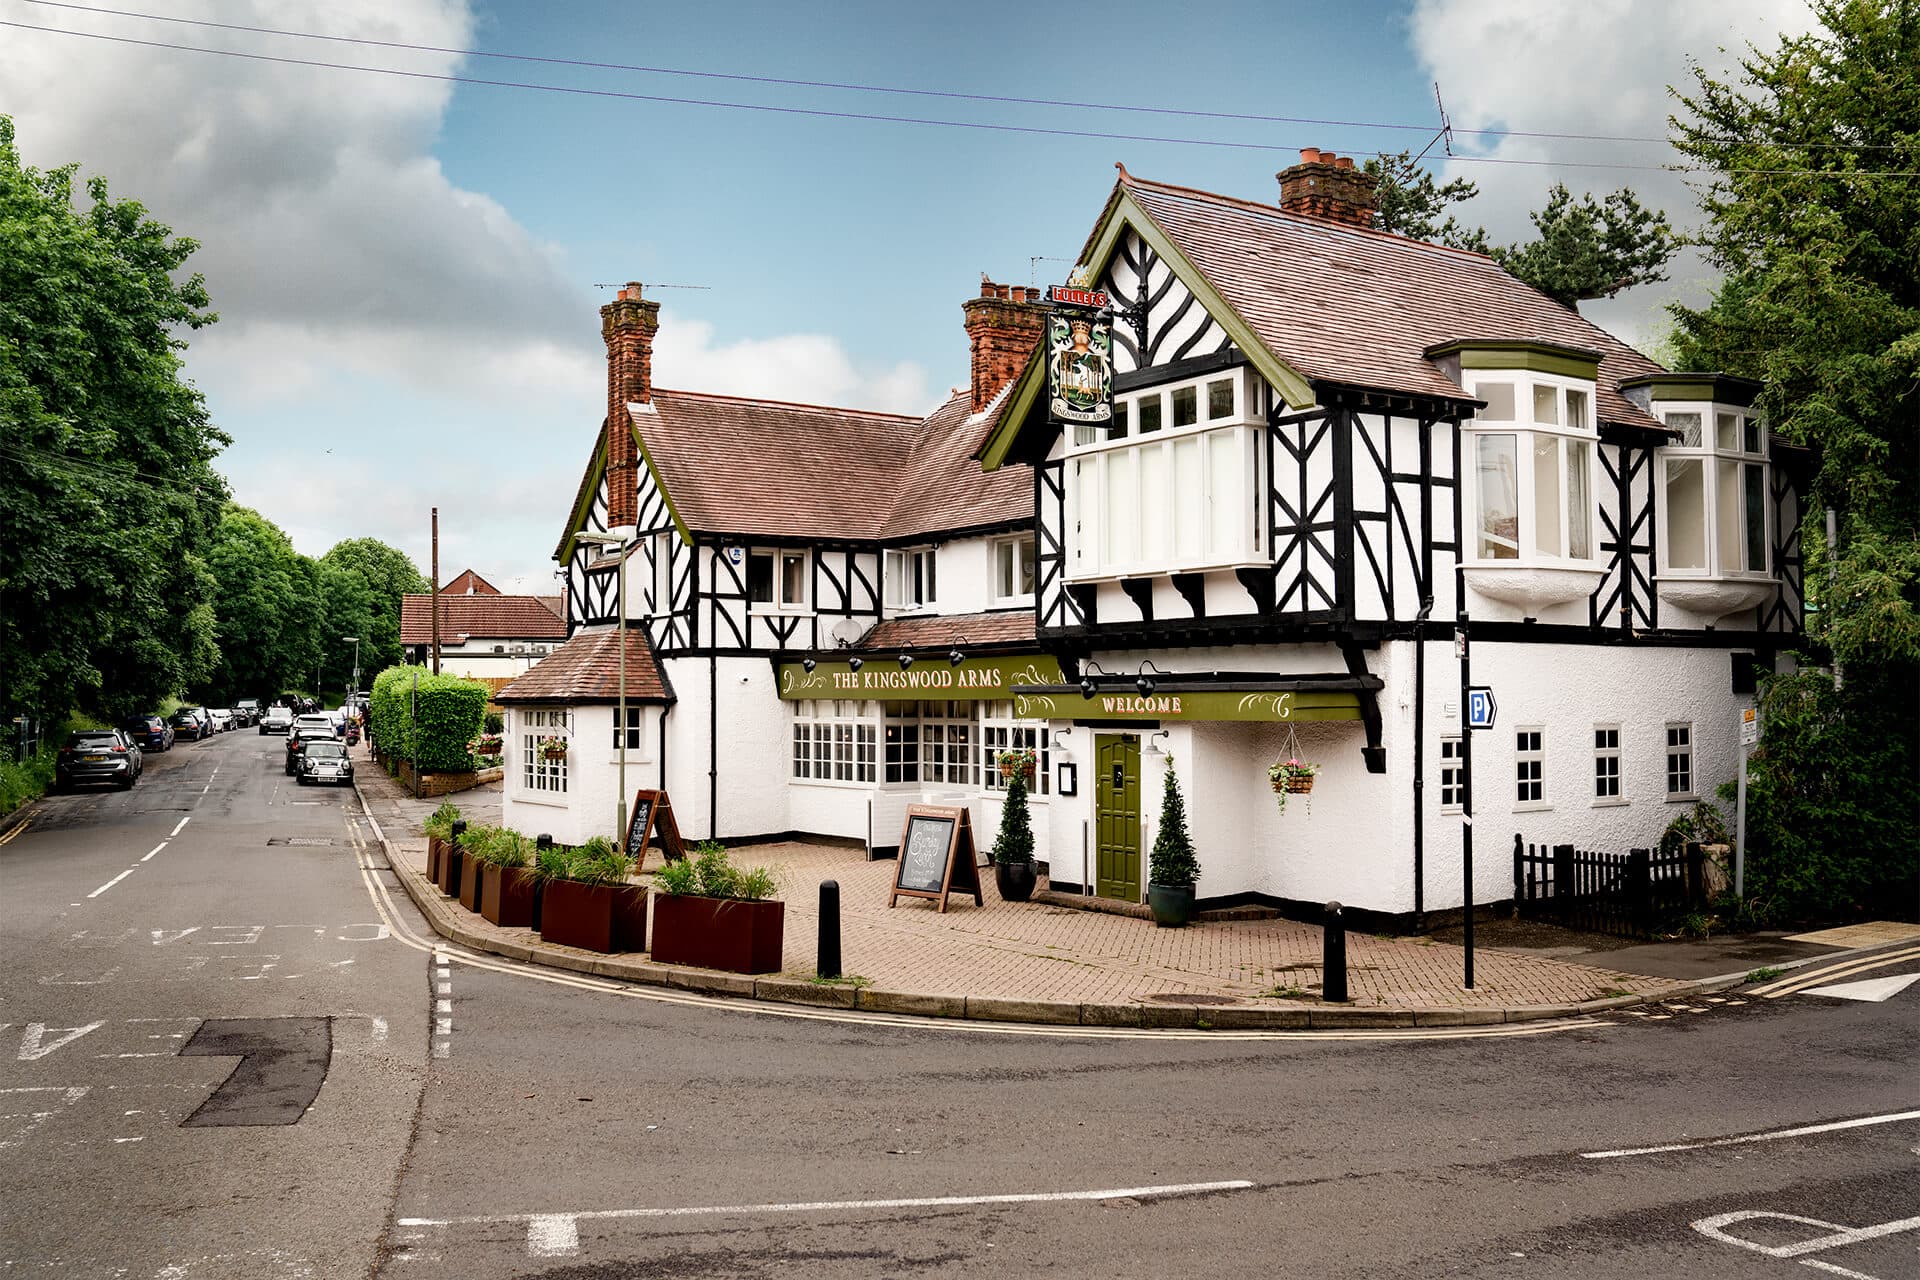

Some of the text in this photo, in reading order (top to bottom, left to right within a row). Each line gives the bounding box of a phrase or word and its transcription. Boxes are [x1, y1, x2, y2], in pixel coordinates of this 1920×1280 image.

[833, 668, 1001, 689] THE KINGSWOOD ARMS
[1102, 697, 1182, 713] WELCOME
[1474, 696, 1483, 720] P
